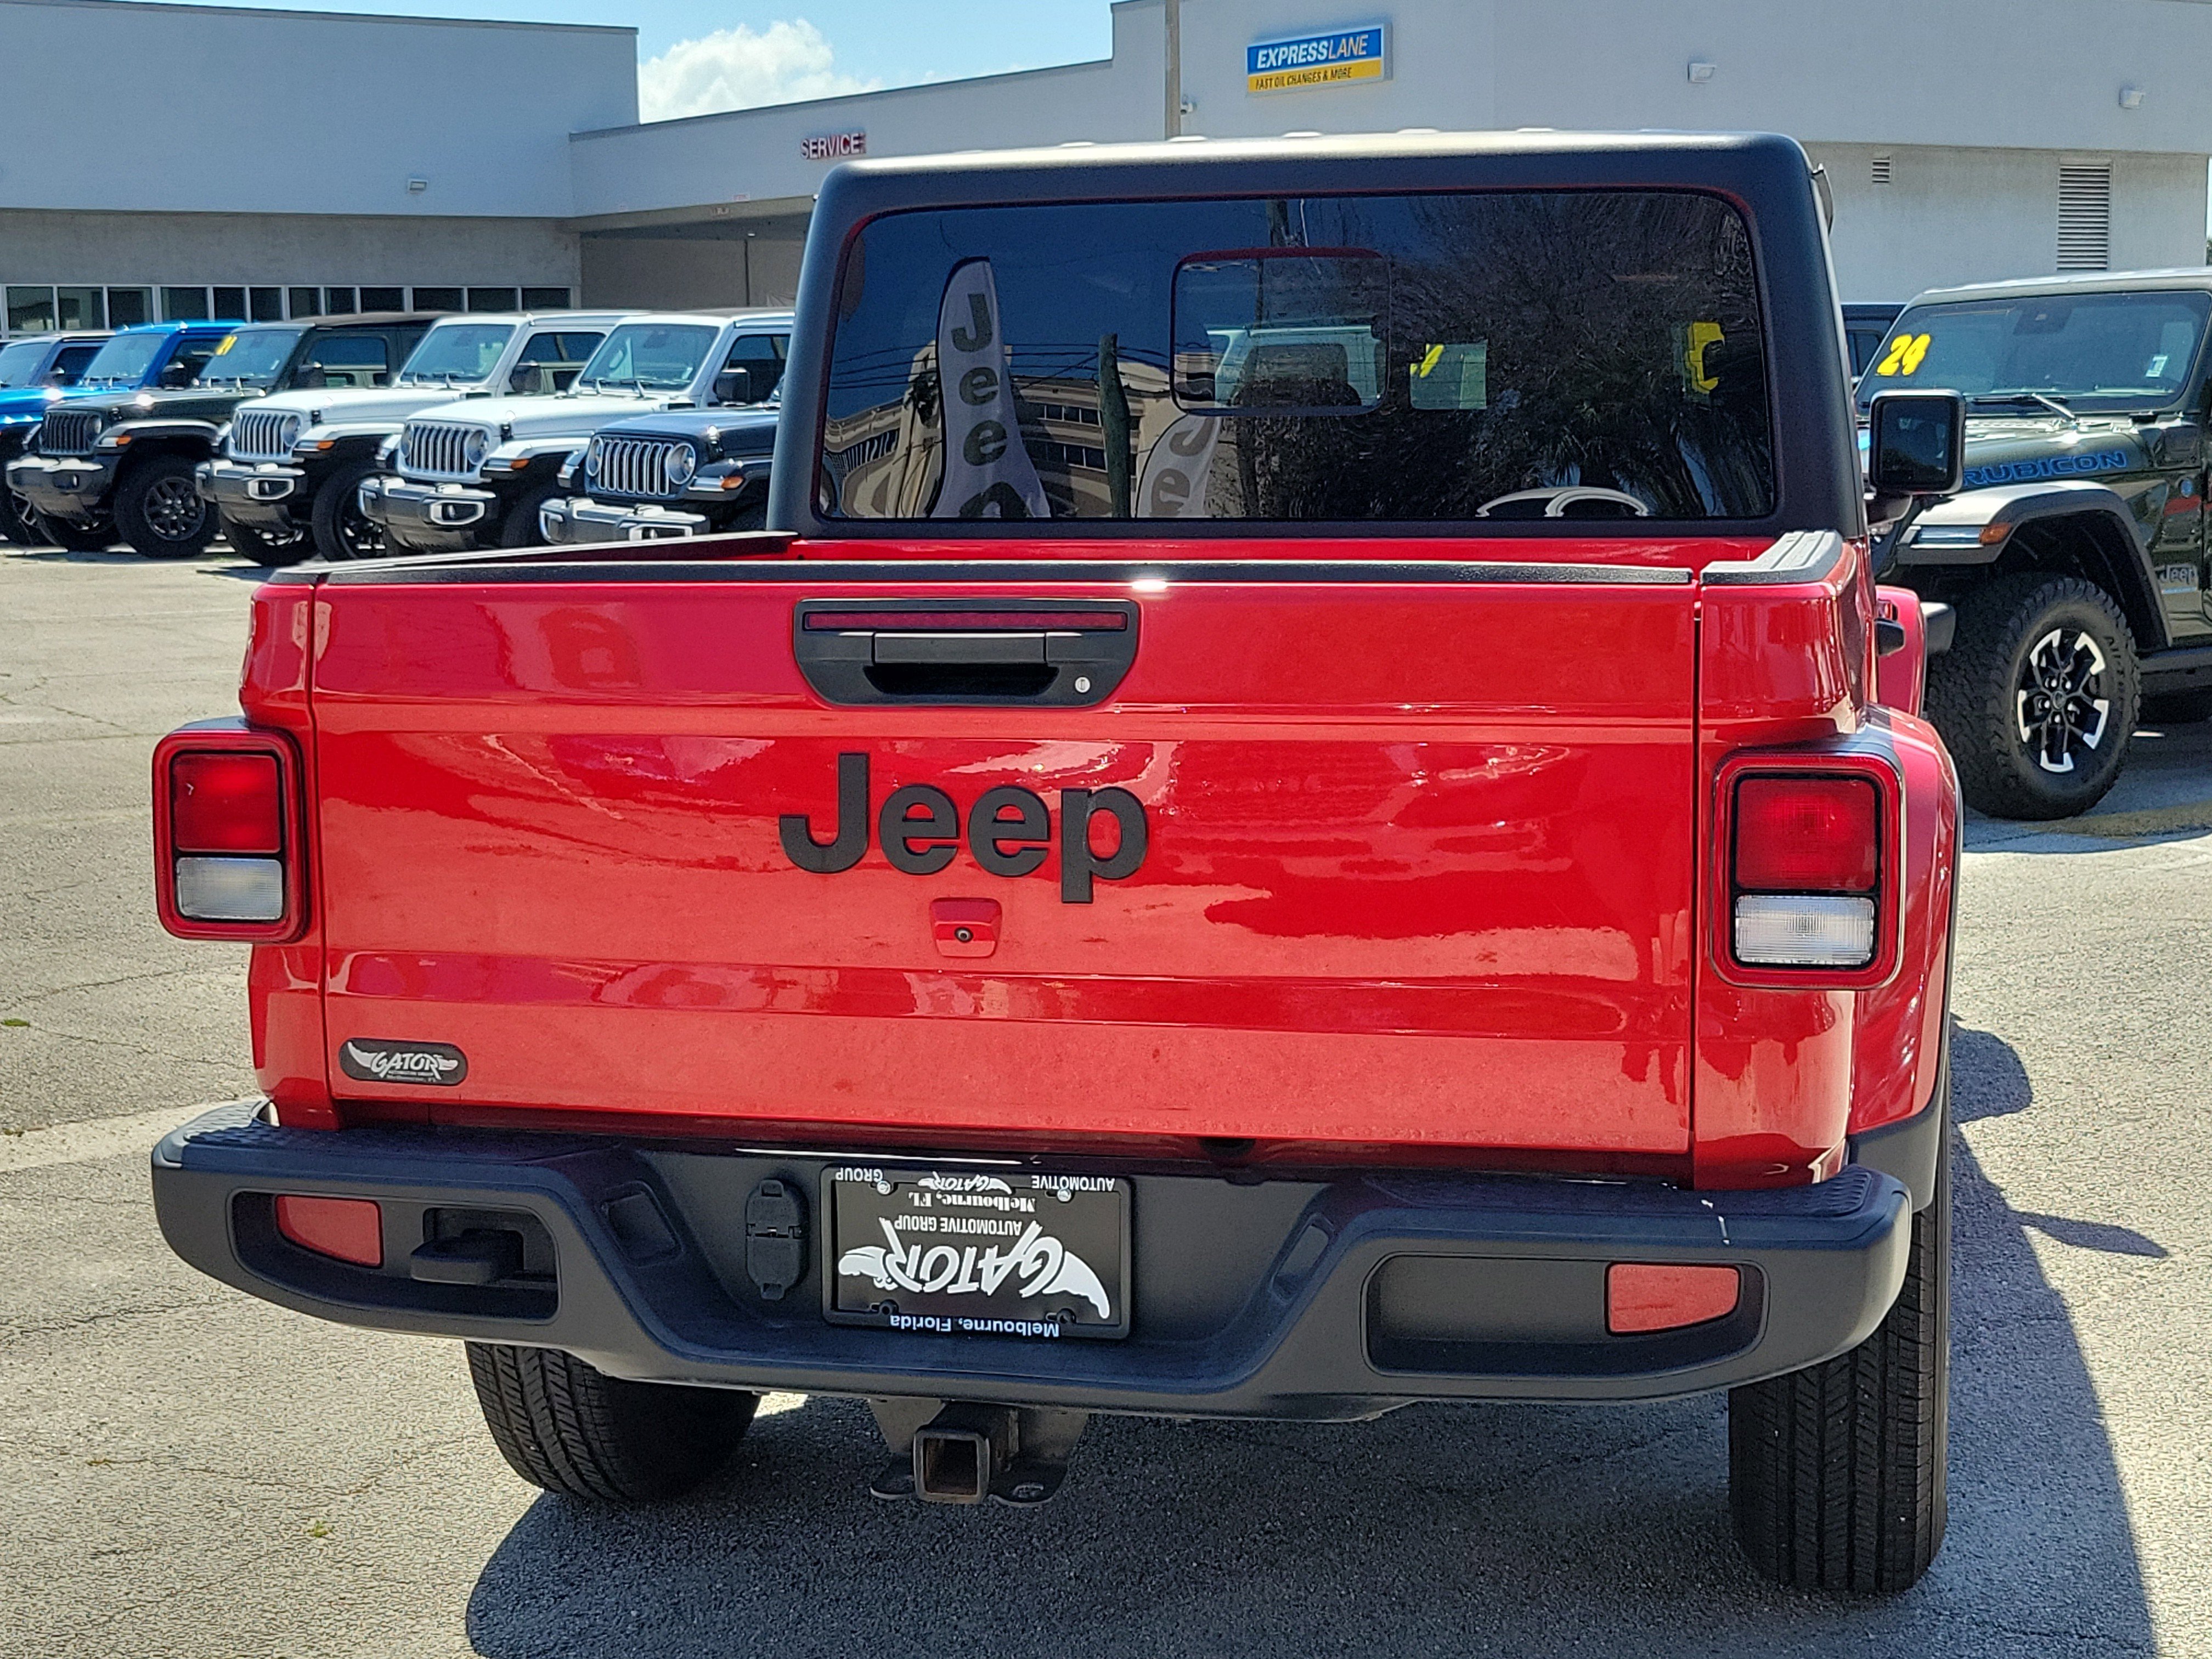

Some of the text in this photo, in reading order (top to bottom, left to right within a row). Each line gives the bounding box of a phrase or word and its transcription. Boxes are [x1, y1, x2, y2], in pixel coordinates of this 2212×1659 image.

[1257, 35, 1368, 69] EXPRESSLANE
[1256, 67, 1352, 90] FAST OIL CHANGES & MORE
[801, 133, 865, 160] SERVICE
[1877, 334, 1931, 375] 24
[1963, 452, 2126, 487] RUBICON
[2159, 565, 2196, 585] Jeep
[779, 753, 1148, 904] Jeep
[371, 1052, 442, 1080] GATOR
[836, 1167, 883, 1182] GROUP
[932, 1171, 990, 1192] GATOR
[1031, 1175, 1115, 1191] AUTOMOTIVE
[909, 1191, 1035, 1212] Melbourne, FL
[894, 1215, 1022, 1235] AUTOMOTIVE GROUP
[879, 1217, 1063, 1298] GATOR
[890, 1315, 1059, 1337] Melbourne, Florida
